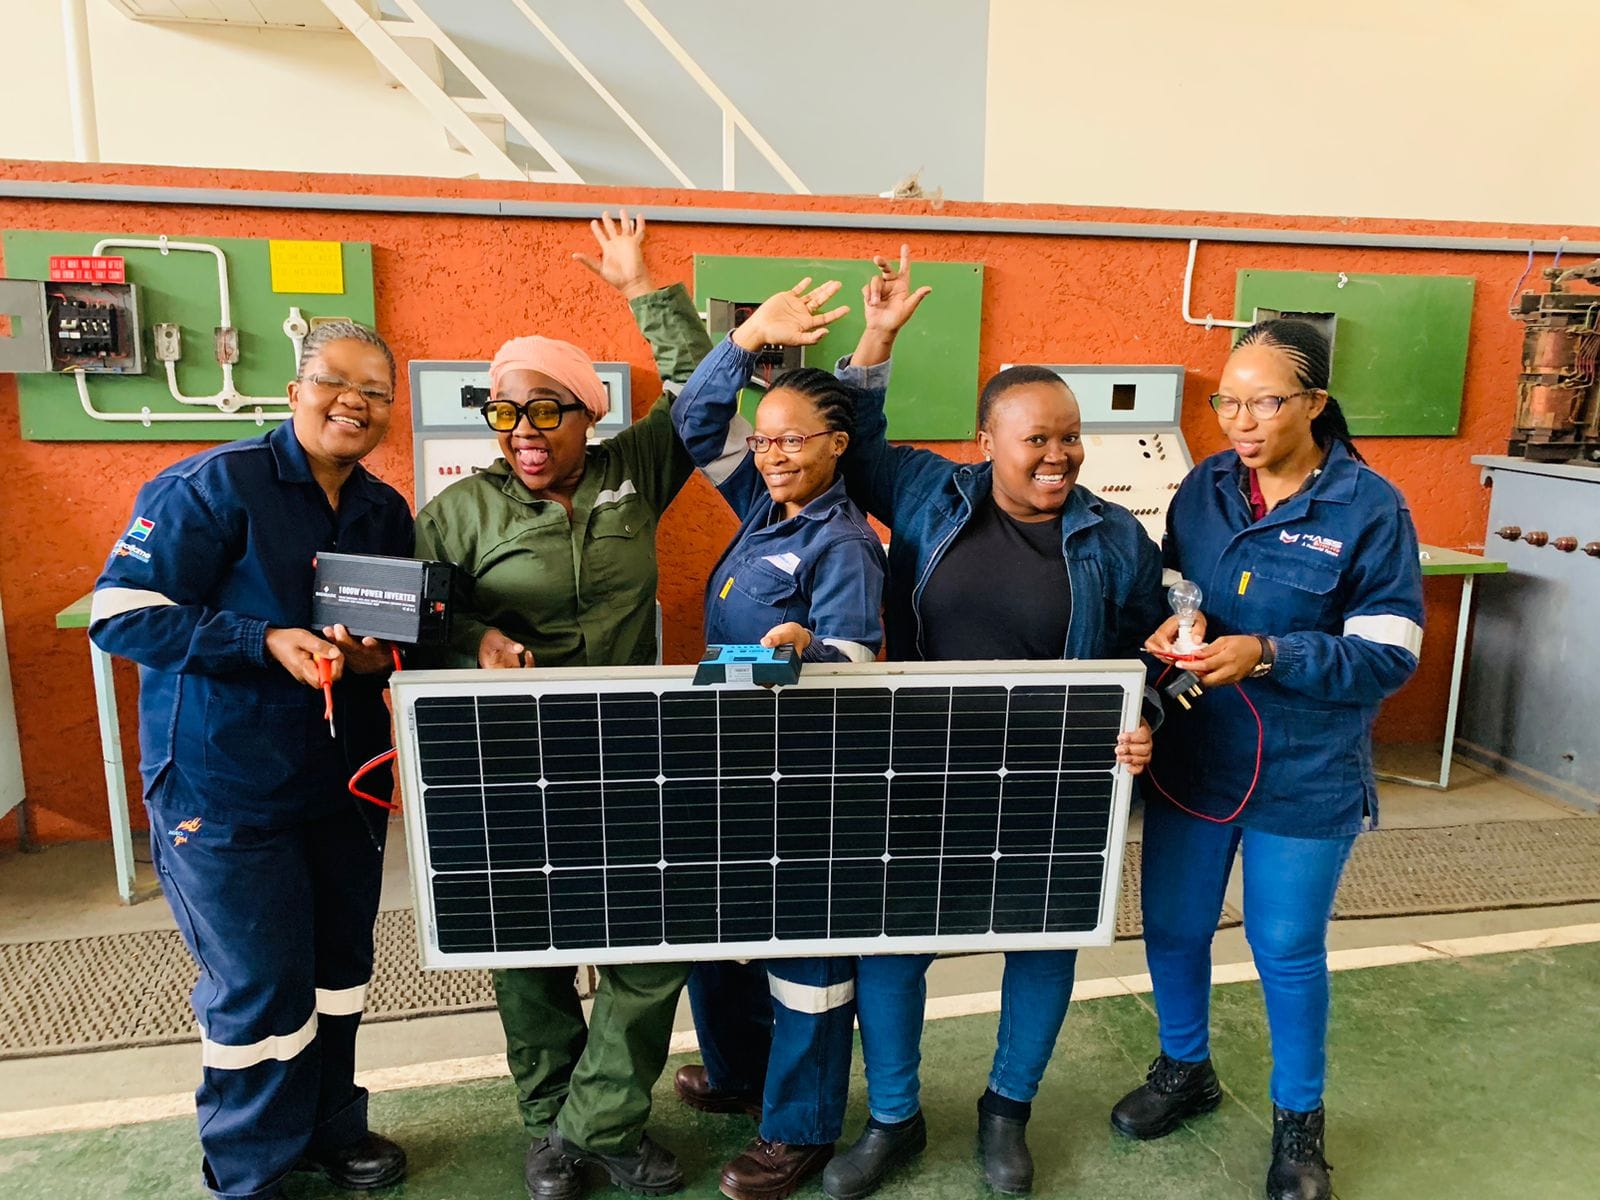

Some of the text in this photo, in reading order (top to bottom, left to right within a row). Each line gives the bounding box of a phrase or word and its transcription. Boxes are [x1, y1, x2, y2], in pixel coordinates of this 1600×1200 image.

[1302, 534, 1343, 548] MASS
[338, 586, 361, 596] 1000W
[360, 588, 384, 599] POWER
[384, 591, 416, 603] INVERTER
